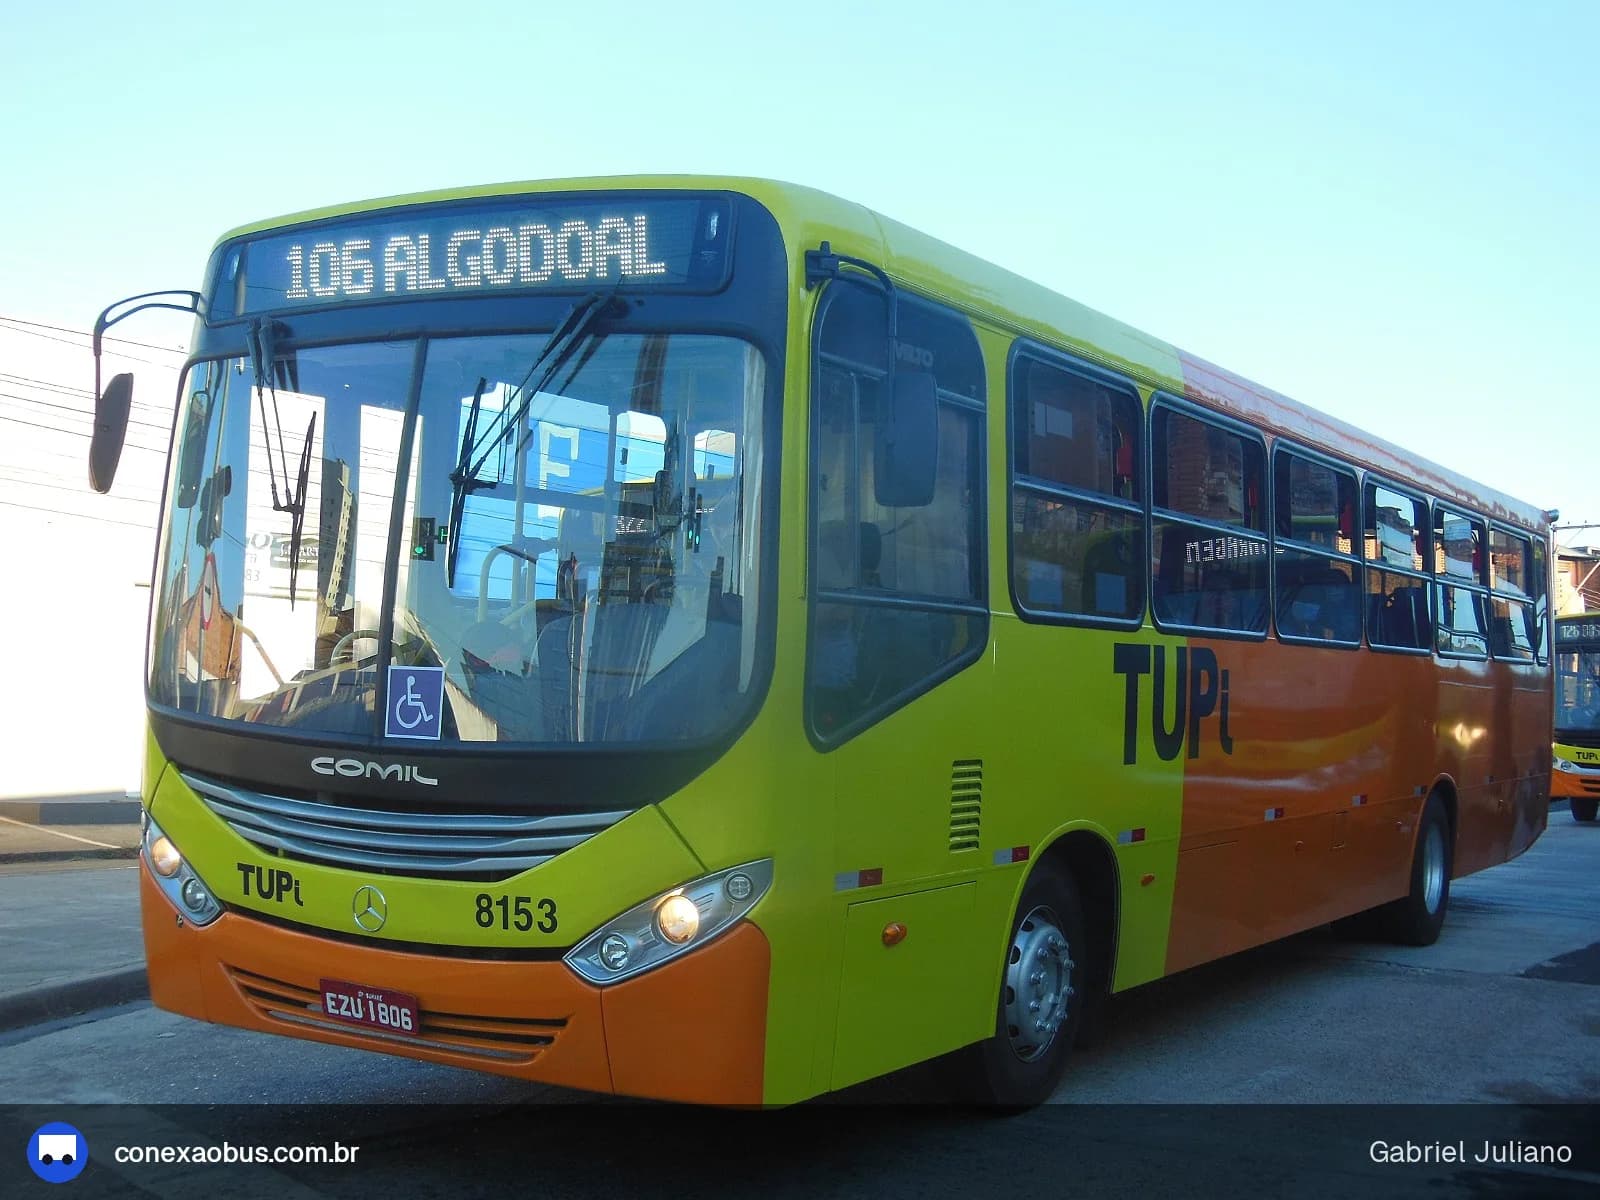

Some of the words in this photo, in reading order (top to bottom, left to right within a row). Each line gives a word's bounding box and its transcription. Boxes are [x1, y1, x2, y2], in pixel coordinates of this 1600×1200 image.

[286, 239, 373, 299] 106
[384, 215, 665, 292] ALGODOAL
[311, 756, 438, 786] COMIL
[475, 893, 558, 933] 8153
[368, 1000, 413, 1031] 1806
